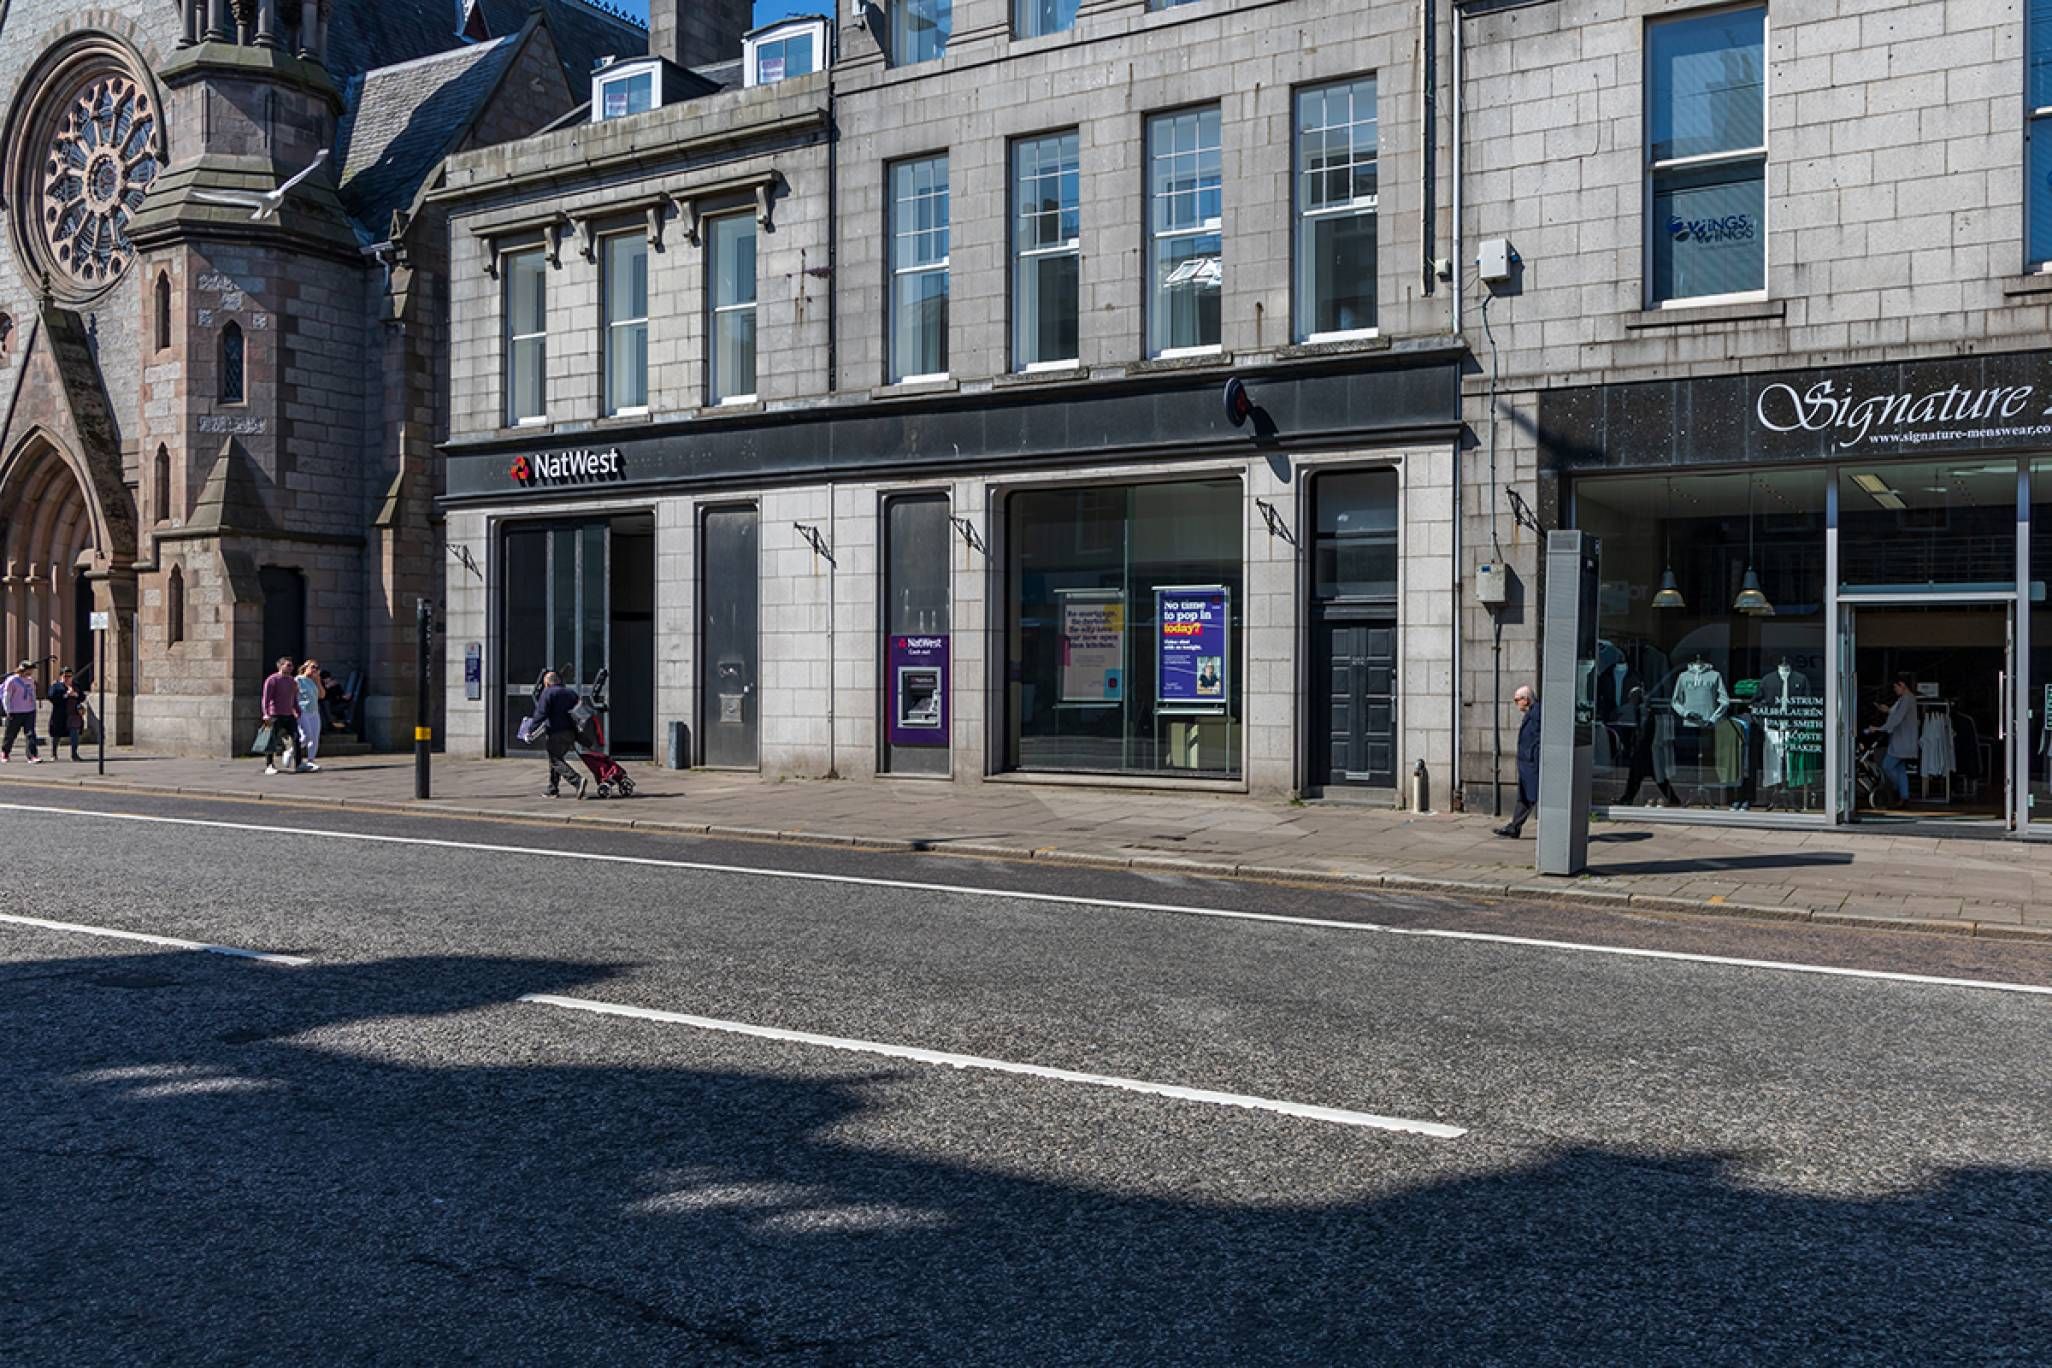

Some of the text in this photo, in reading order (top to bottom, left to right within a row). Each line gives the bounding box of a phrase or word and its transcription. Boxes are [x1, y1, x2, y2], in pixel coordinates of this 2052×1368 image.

[1757, 379, 2033, 447] Signature
[534, 447, 619, 479] NatWest
[1164, 601, 1179, 610] No
[1181, 601, 1206, 610] time
[1164, 610, 1212, 622] to pop in
[1164, 622, 1201, 635] today?
[907, 637, 942, 648] NatWest
